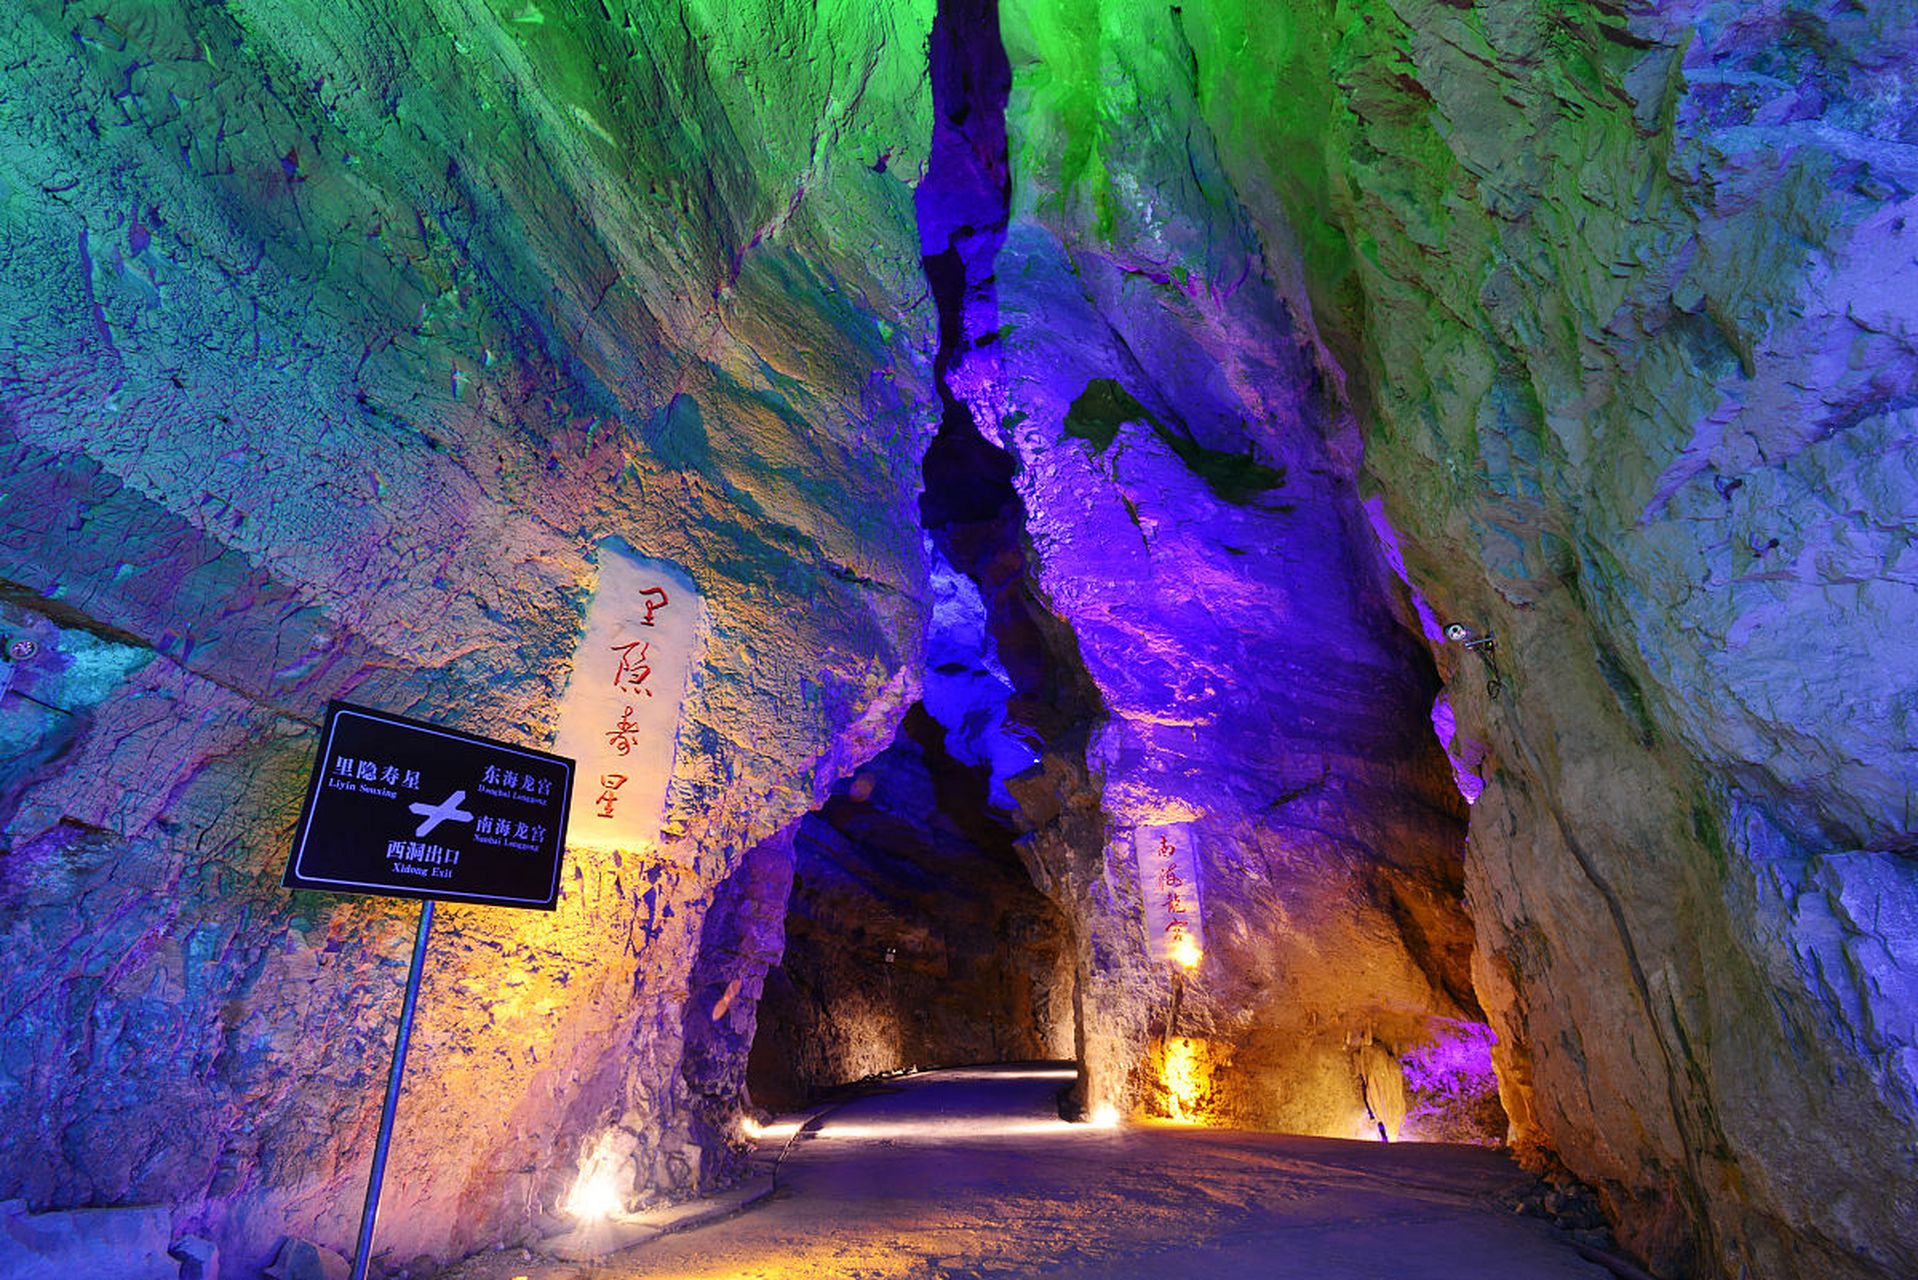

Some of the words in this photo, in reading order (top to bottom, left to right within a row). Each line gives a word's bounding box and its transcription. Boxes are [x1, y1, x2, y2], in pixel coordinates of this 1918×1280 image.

[328, 778, 356, 791] Liyin
[332, 756, 421, 790] 里隐寿星
[481, 765, 553, 796] 东海龙宫
[475, 815, 547, 844] 南海龙宫
[386, 840, 460, 865] 西洞出口
[391, 862, 429, 878] Xidong
[431, 867, 453, 879] Exit
